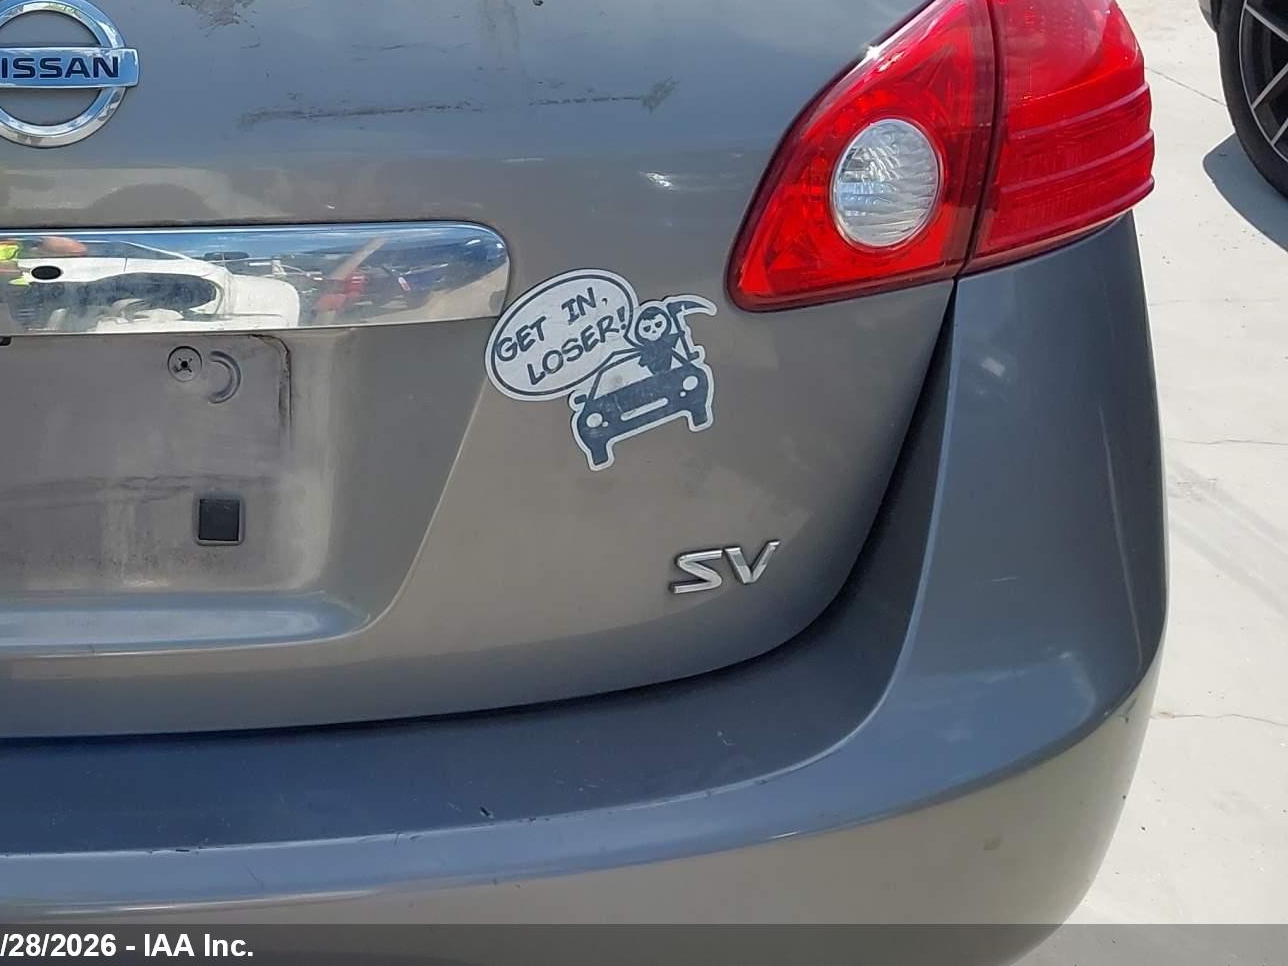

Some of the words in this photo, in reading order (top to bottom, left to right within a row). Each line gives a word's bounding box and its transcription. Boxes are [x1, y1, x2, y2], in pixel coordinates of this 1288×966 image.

[496, 315, 548, 362] GET
[561, 287, 609, 325] IN,
[526, 306, 627, 386] LOSER!
[670, 540, 781, 594] SV
